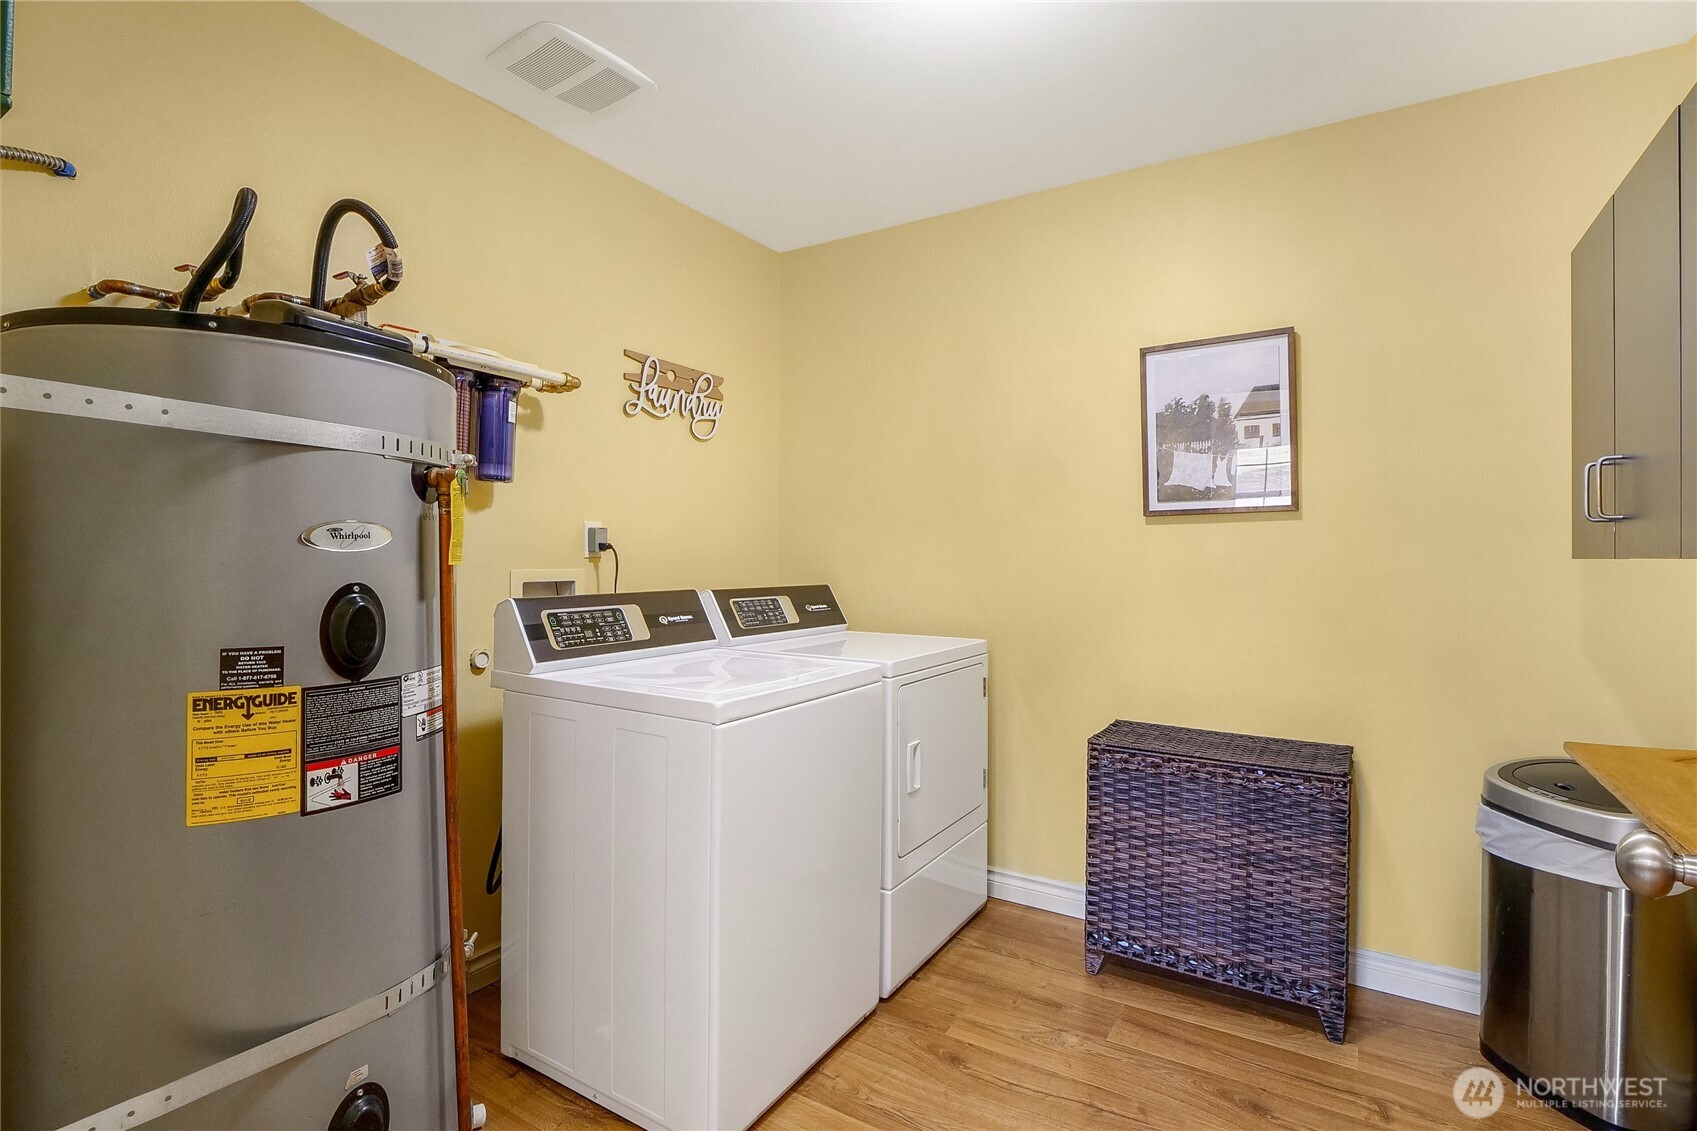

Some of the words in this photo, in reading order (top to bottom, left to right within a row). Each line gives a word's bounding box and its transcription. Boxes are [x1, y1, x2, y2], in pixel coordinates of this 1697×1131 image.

[626, 356, 724, 440] Laundry
[330, 532, 370, 541] Whirlpool
[192, 692, 297, 712] ENERGYGUIDE
[348, 753, 377, 763] DANGER
